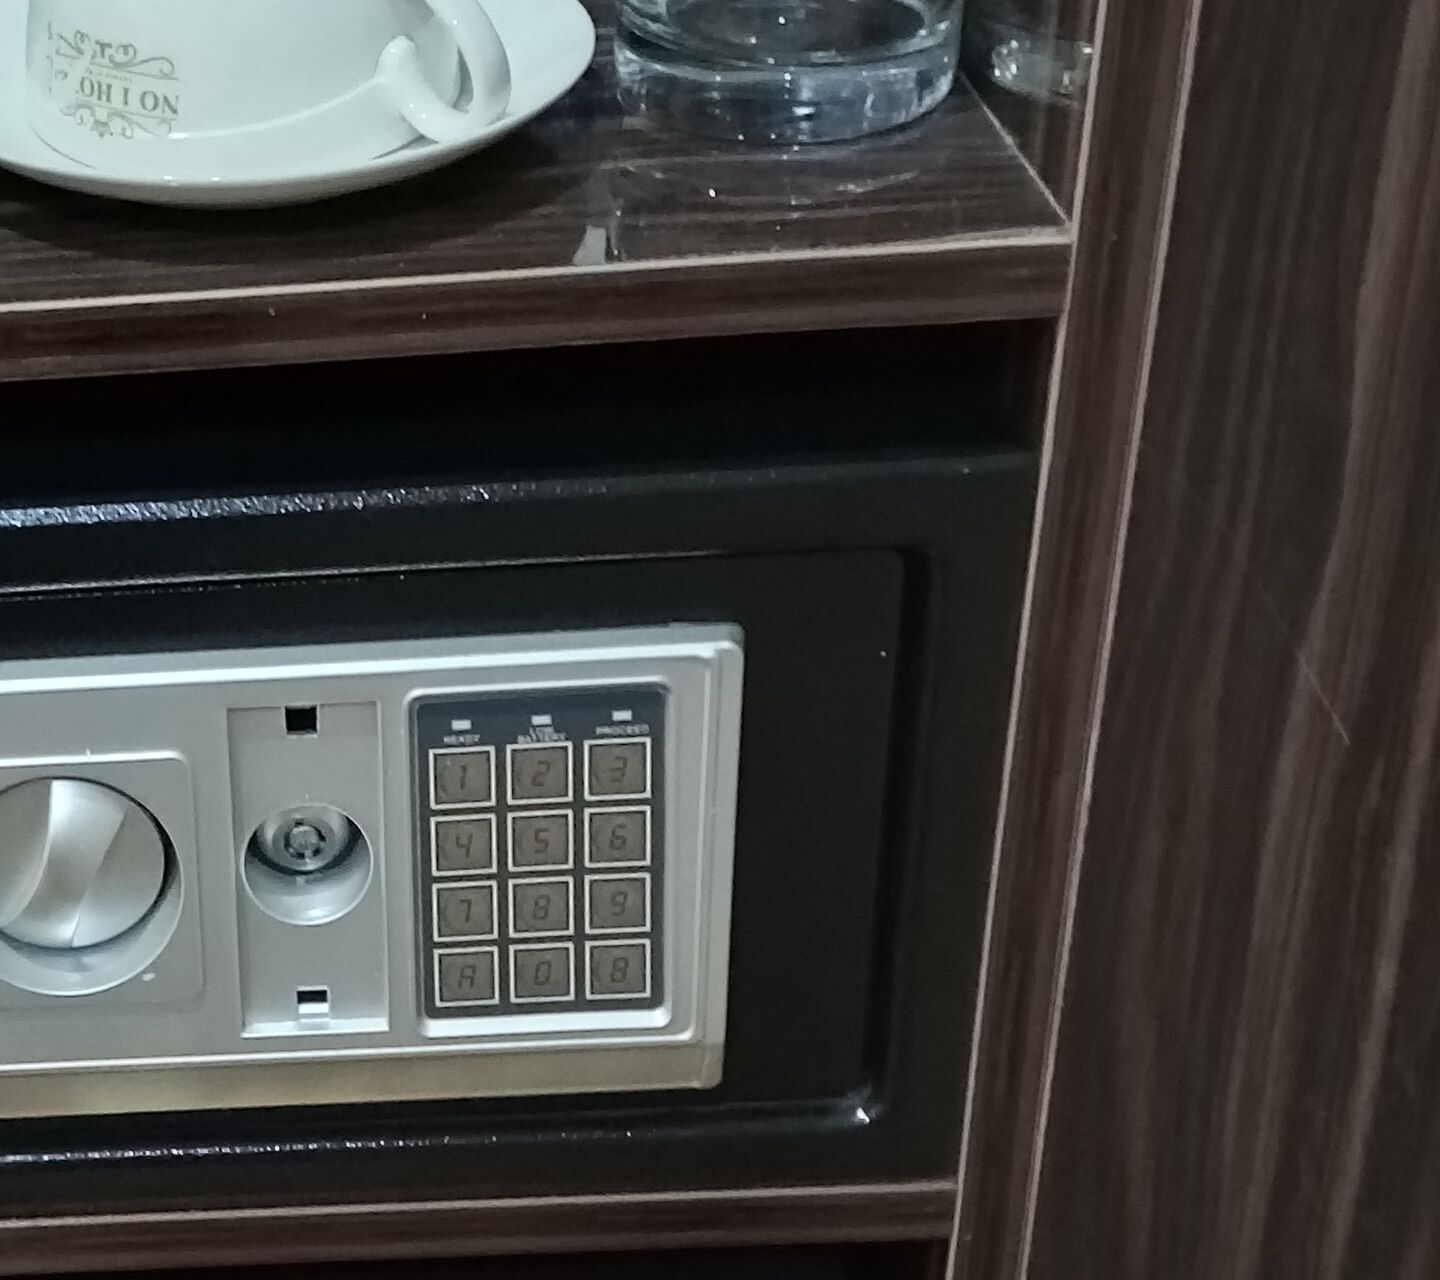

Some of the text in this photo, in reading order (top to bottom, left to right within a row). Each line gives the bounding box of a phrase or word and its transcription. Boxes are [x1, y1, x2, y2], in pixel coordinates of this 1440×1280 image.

[531, 760, 551, 787] 2
[610, 756, 627, 782] 3
[455, 832, 473, 859] 4
[533, 827, 550, 853] 5
[610, 823, 627, 851] 6
[459, 898, 473, 923] 7
[532, 894, 551, 920] 8
[611, 890, 628, 916] 9
[458, 964, 476, 989] A
